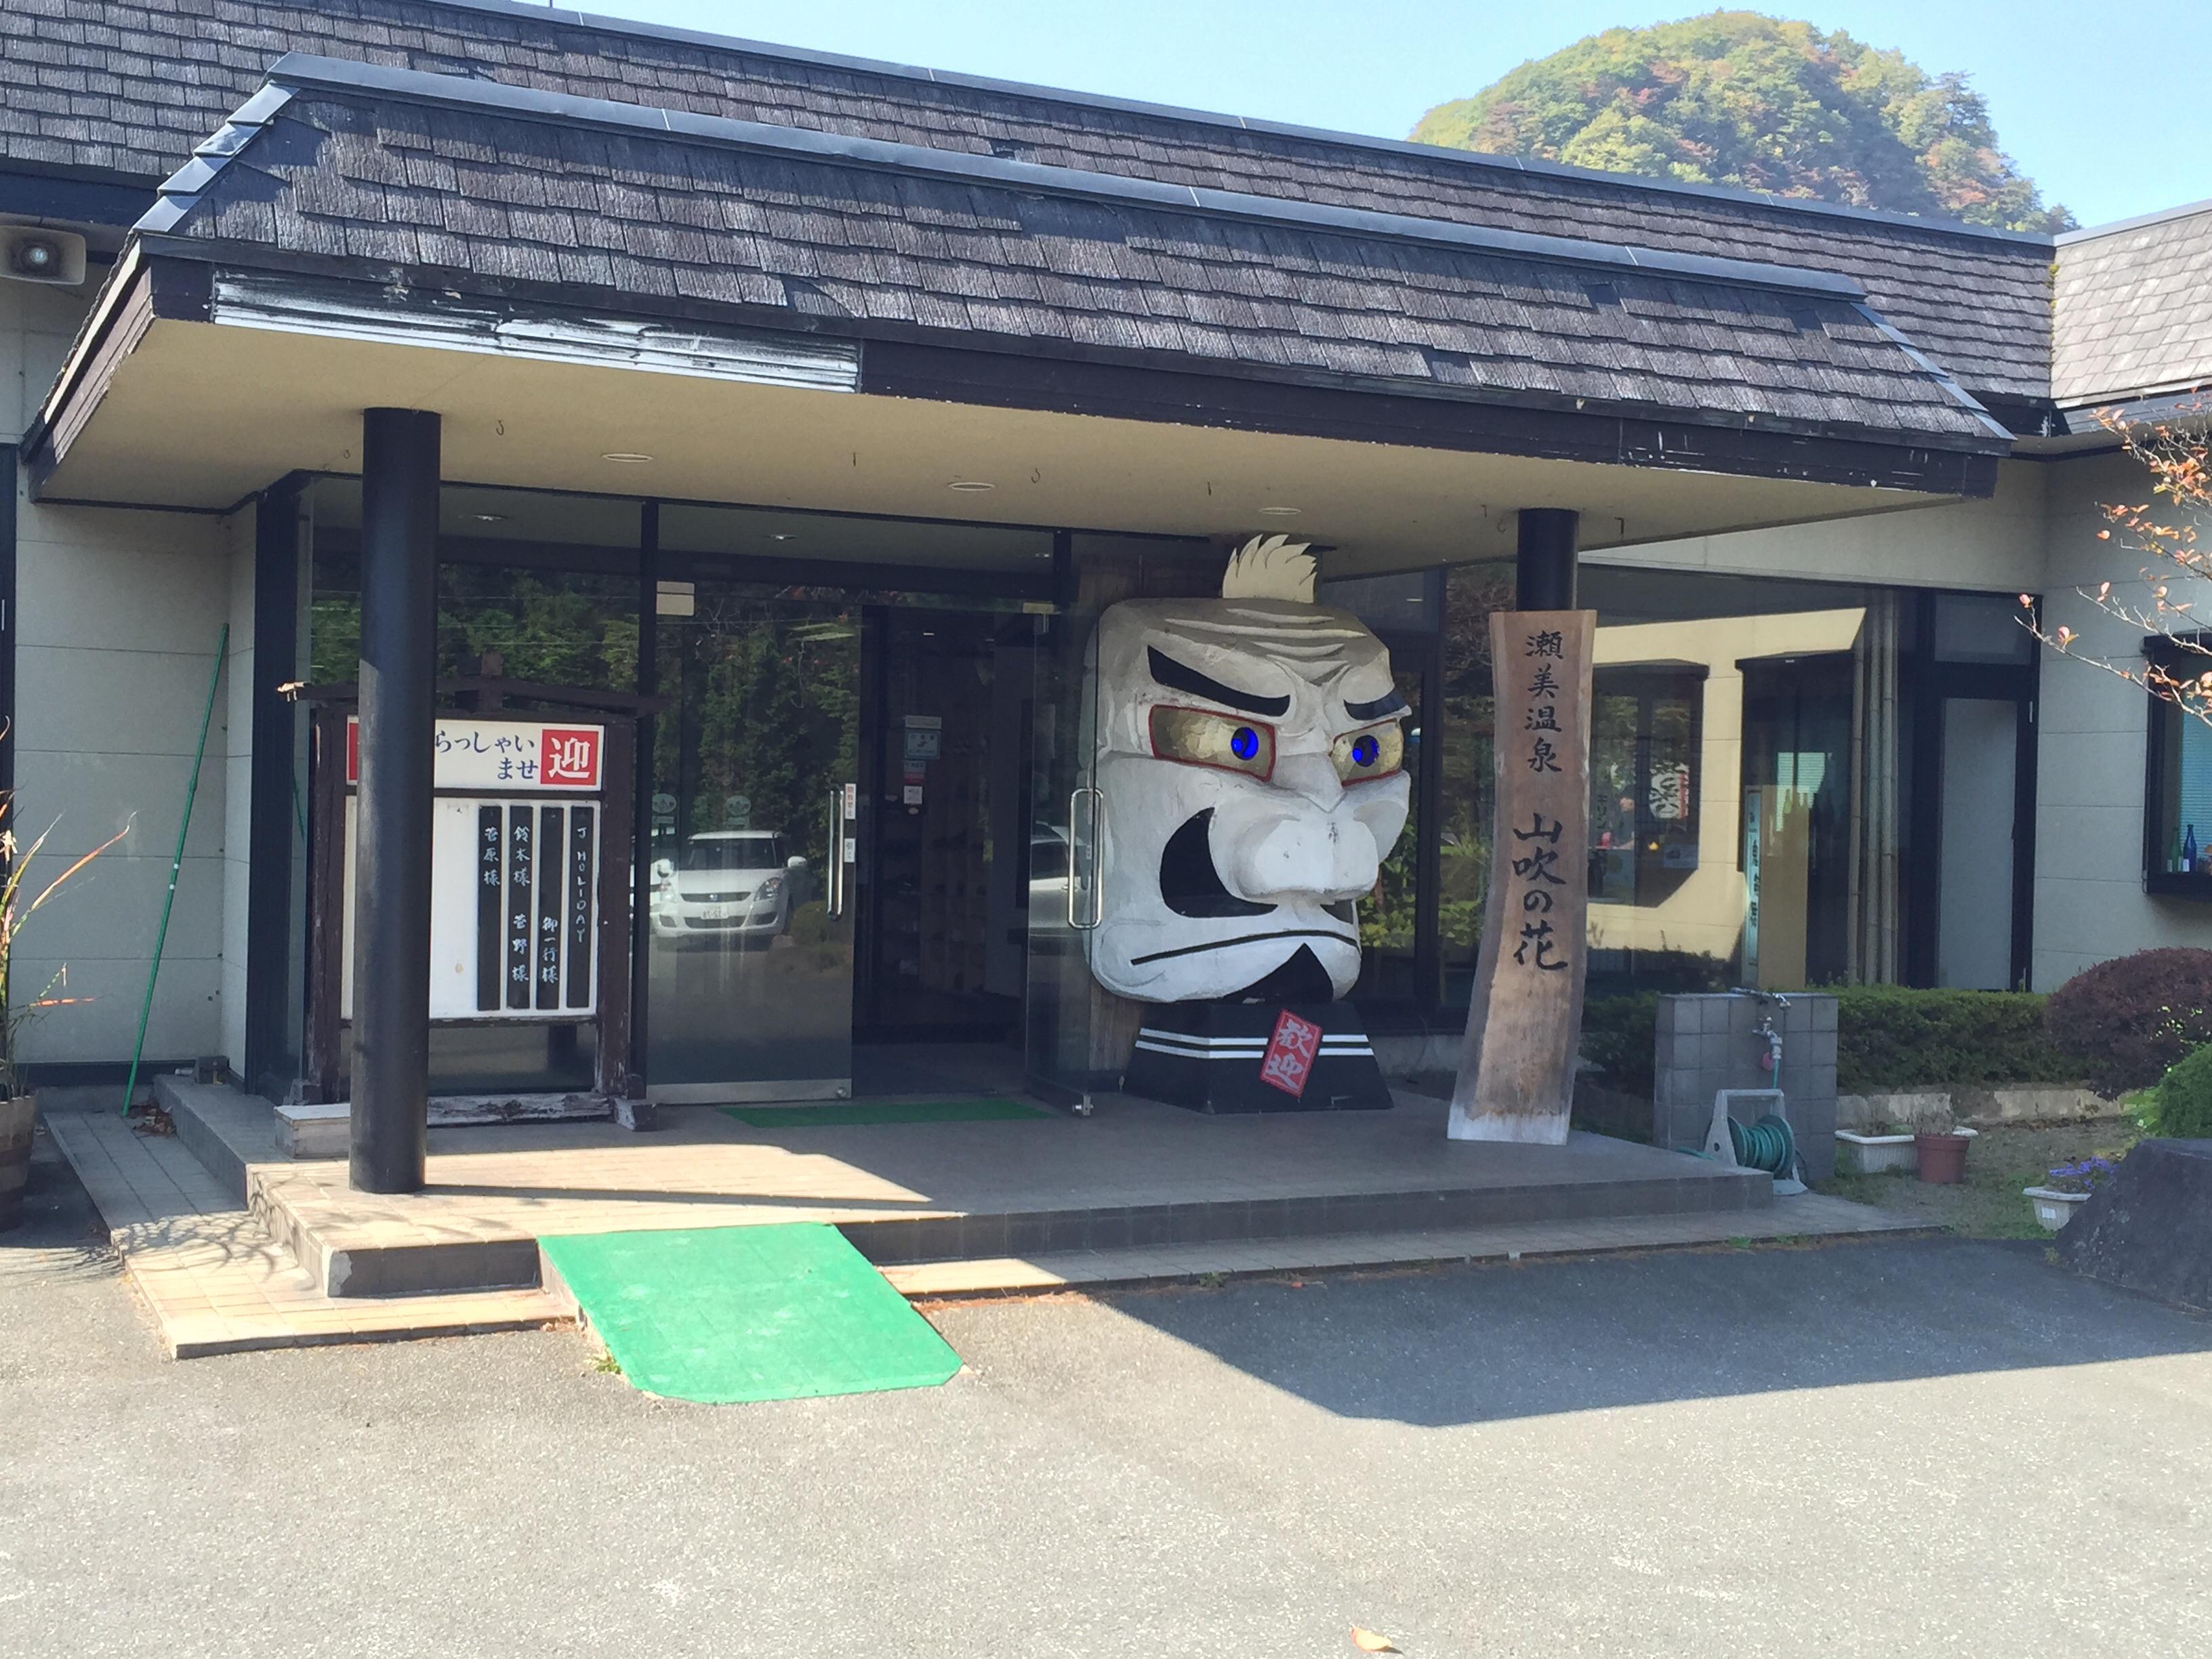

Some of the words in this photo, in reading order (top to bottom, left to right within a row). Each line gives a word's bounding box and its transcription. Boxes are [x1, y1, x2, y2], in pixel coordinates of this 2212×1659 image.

[1525, 630, 1563, 773] 瀬美温泉
[497, 758, 539, 779] ませ
[548, 737, 590, 778] 迎
[513, 825, 531, 886] 鈴木様
[575, 851, 587, 943] HOLIDAY
[1513, 813, 1568, 971] 山吹の花
[541, 916, 558, 983] 御一行様
